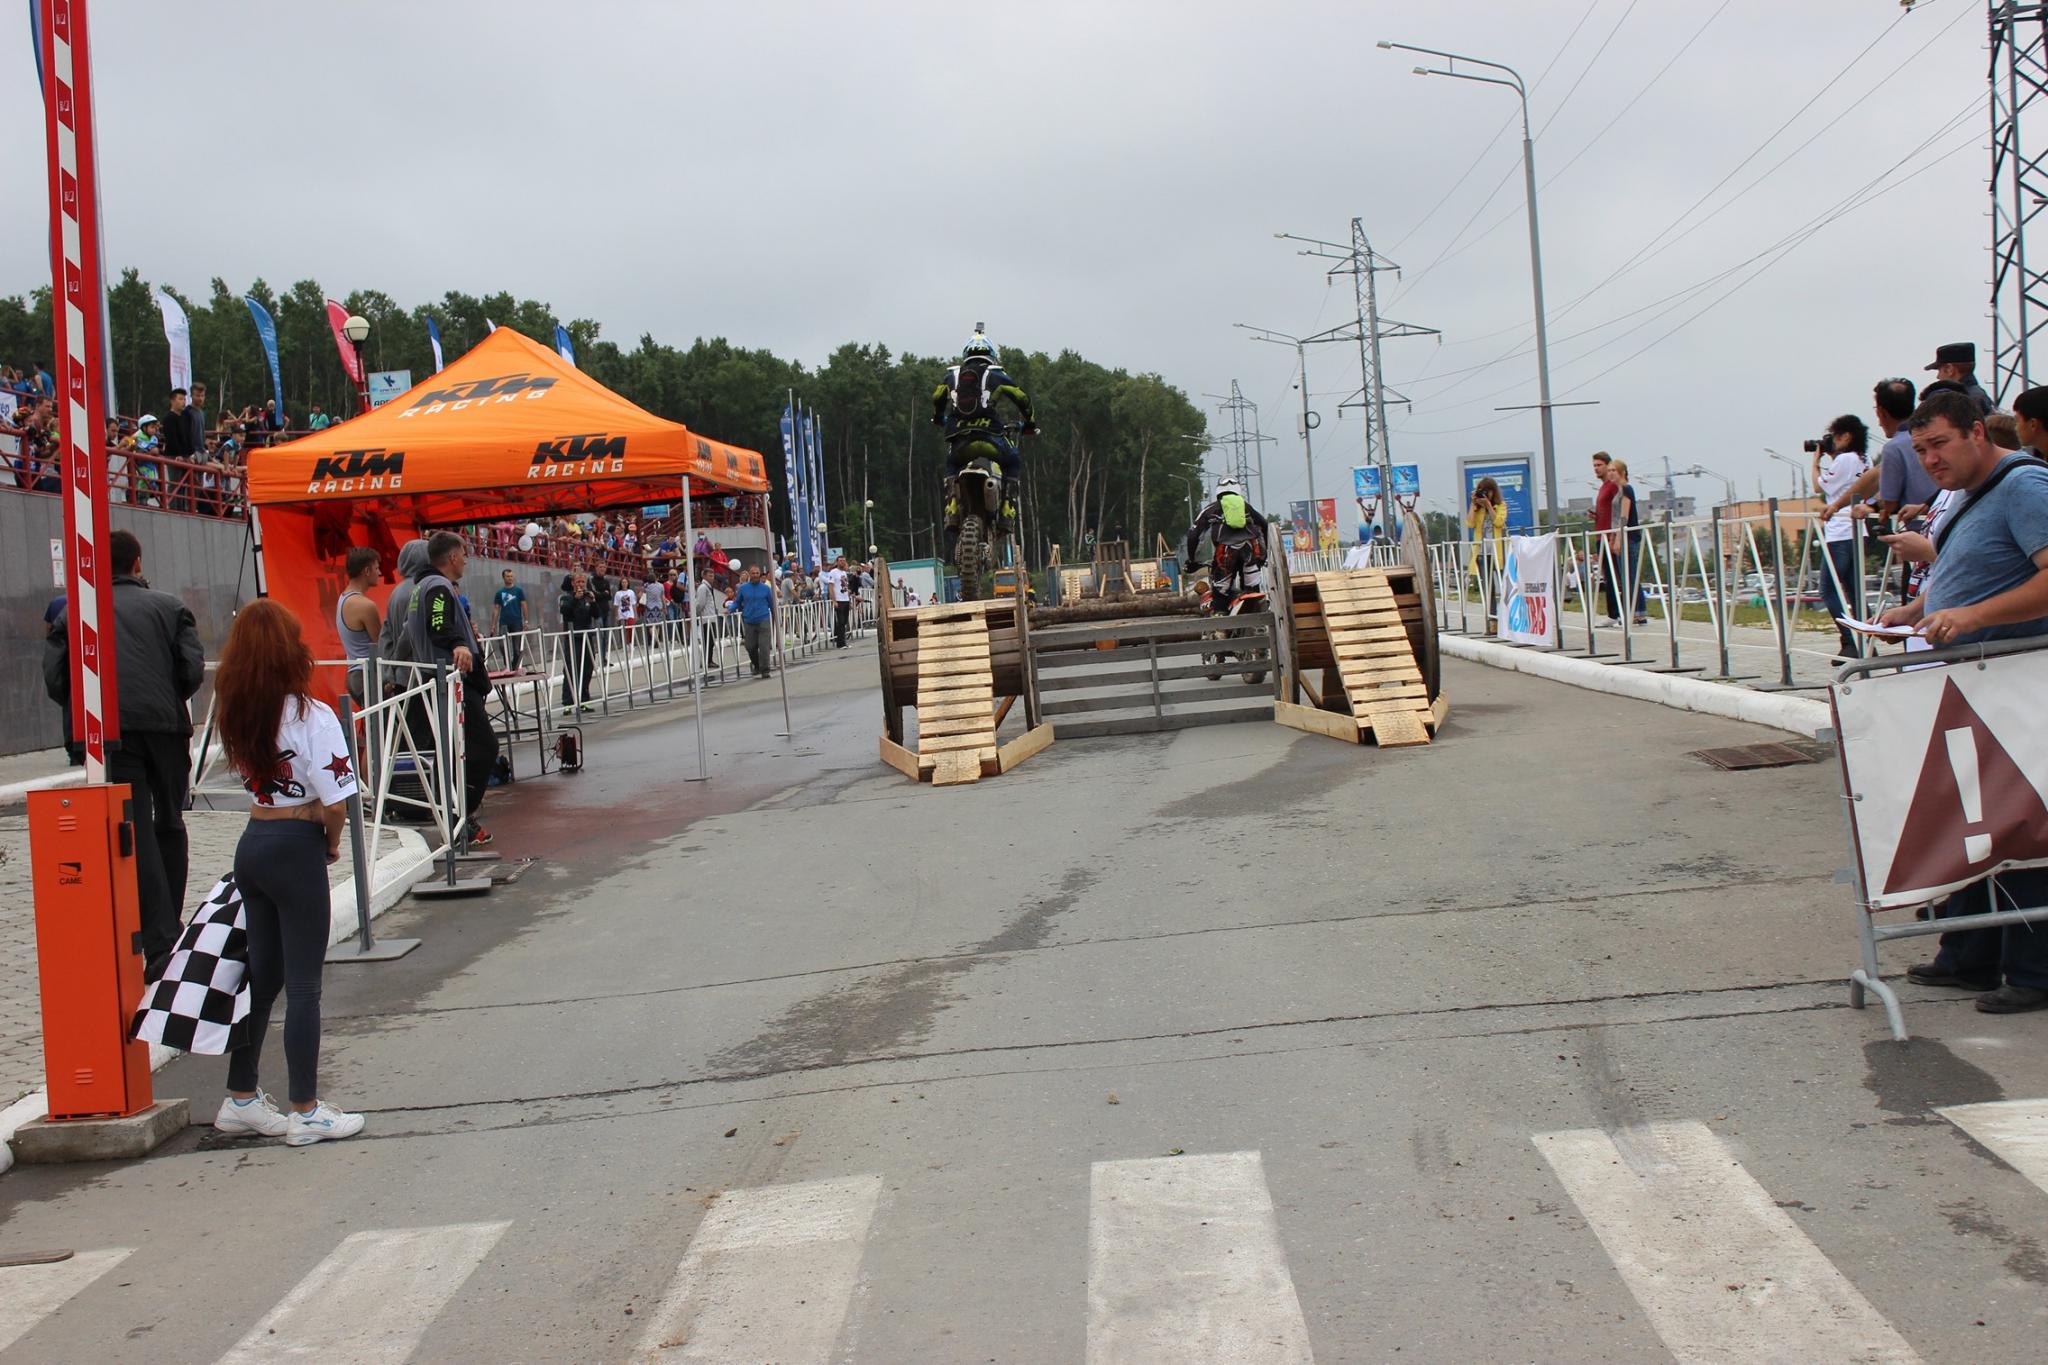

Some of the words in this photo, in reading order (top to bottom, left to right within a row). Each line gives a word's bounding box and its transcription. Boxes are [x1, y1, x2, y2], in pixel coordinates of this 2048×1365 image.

[410, 373, 560, 409] KTM
[312, 448, 405, 480] KTM
[531, 433, 627, 465] KTM
